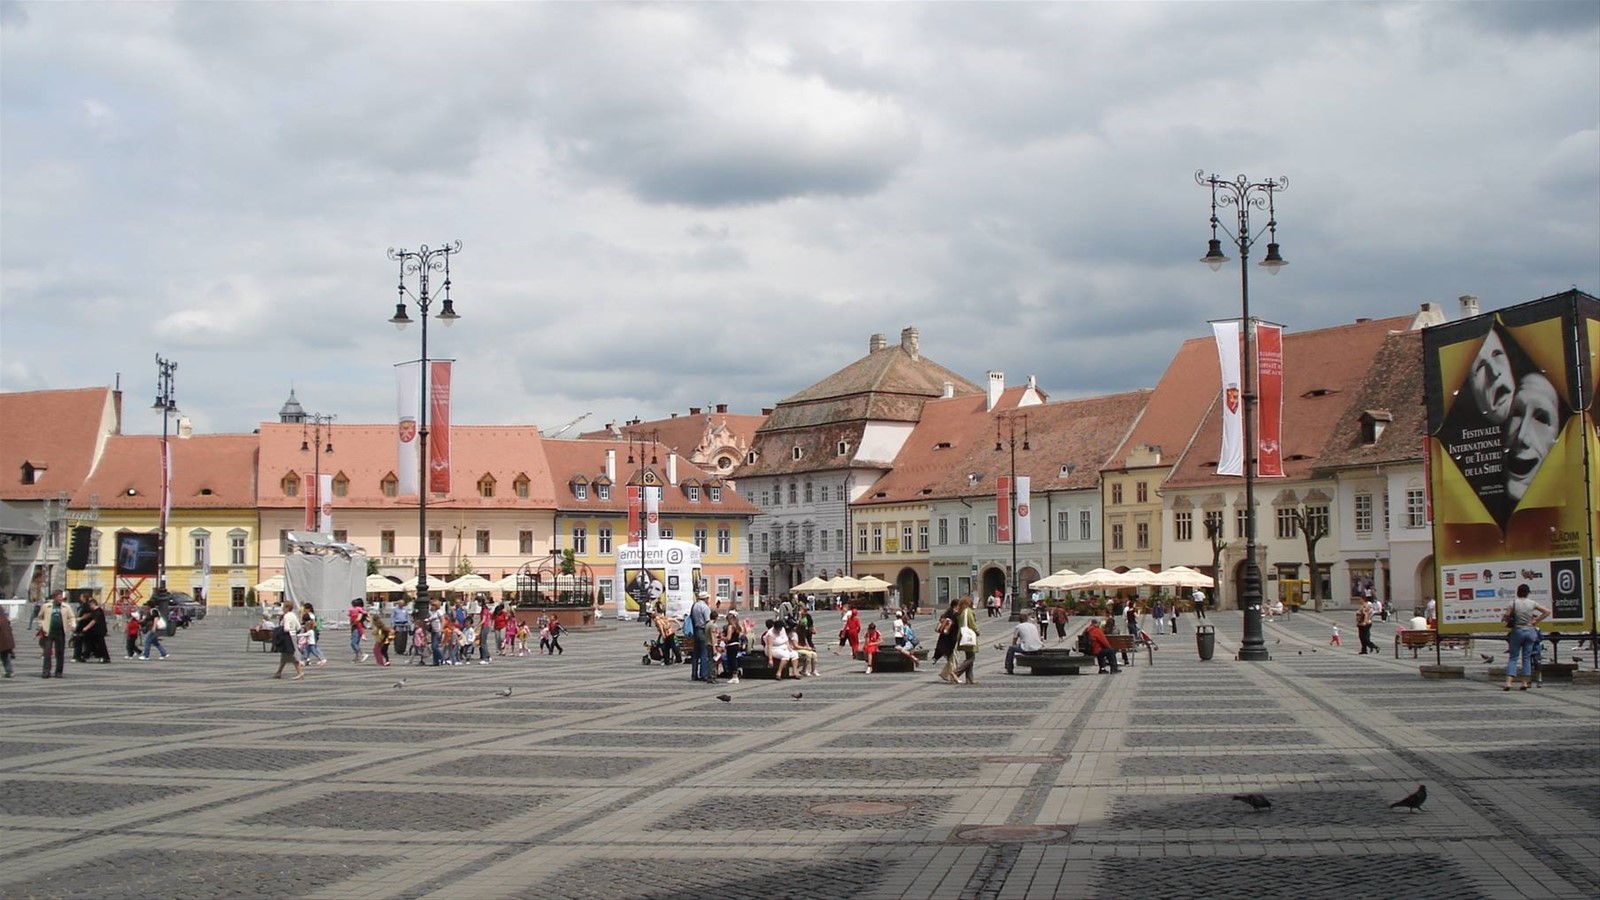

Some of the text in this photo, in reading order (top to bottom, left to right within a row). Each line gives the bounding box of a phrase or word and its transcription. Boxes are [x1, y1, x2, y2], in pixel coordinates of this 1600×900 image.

[1462, 426, 1501, 439] FESTIVALUL
[1465, 451, 1502, 464] DE TEATRU
[1465, 463, 1502, 477] DE LA SIBIU
[1555, 597, 1579, 607] ambient
